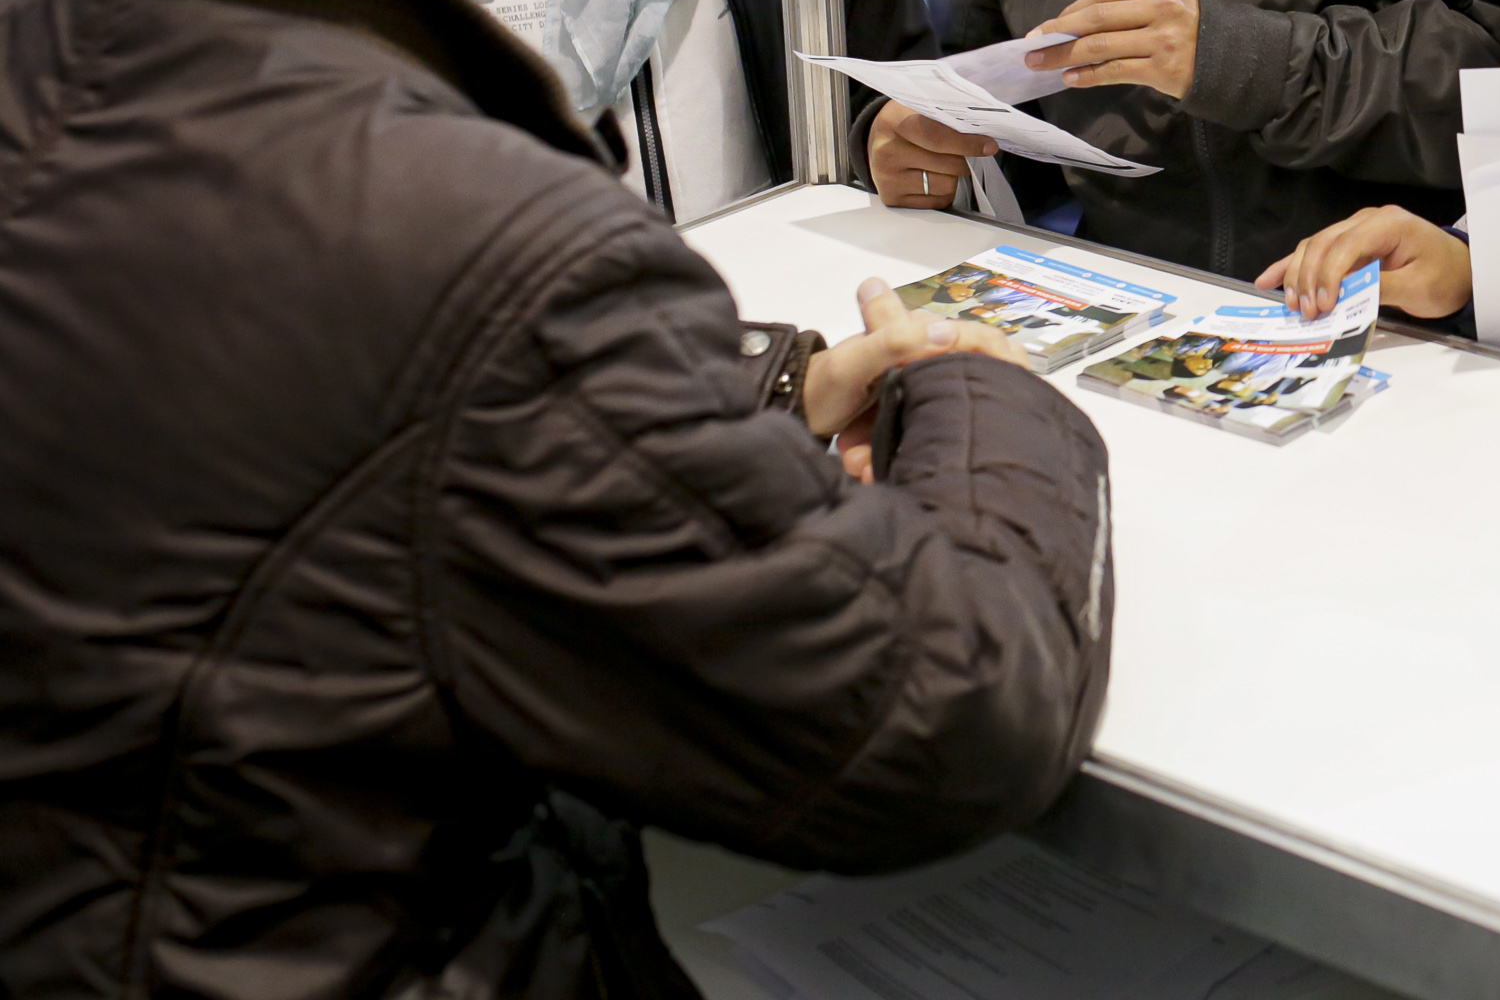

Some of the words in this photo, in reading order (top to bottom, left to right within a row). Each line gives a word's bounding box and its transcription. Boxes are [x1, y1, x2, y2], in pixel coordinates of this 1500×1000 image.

[496, 4, 528, 14] SERIES
[502, 10, 547, 22] CHALLENG
[511, 22, 534, 32] CITY
